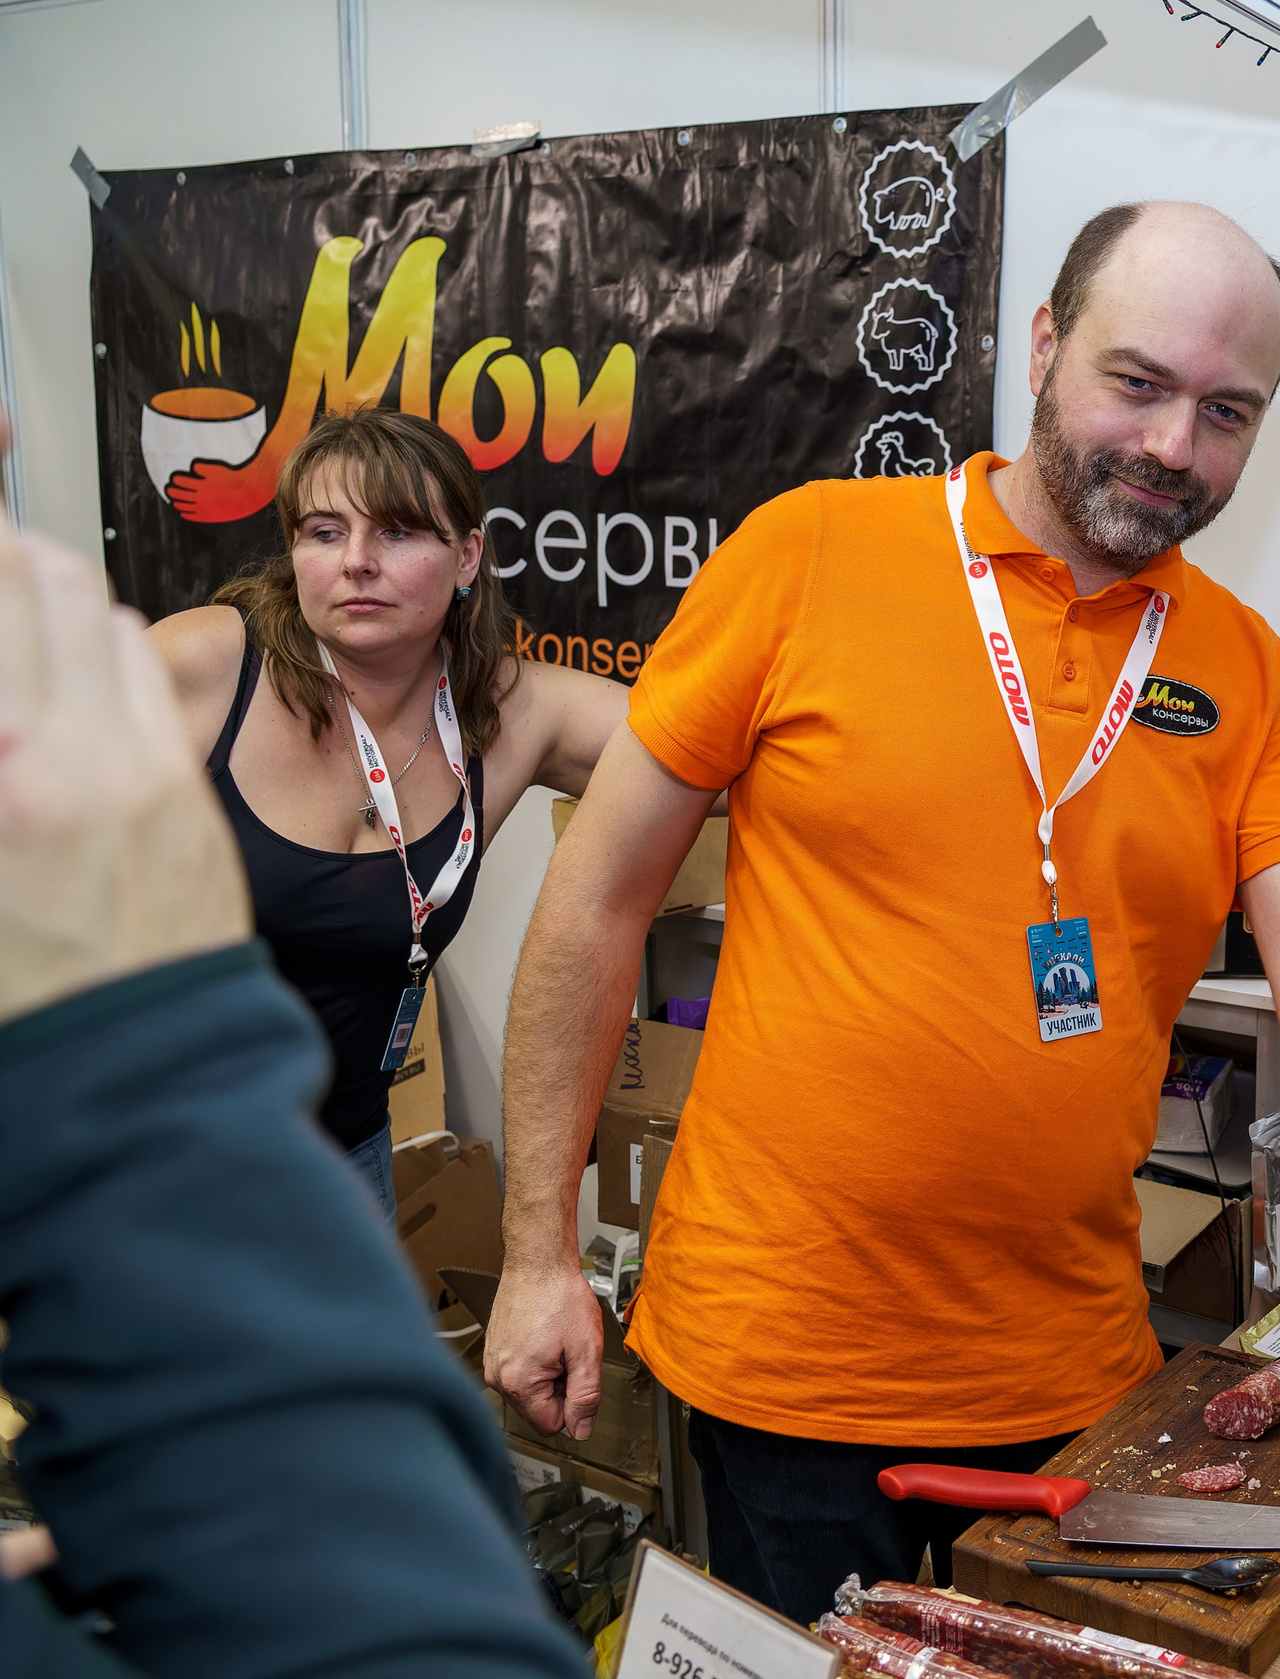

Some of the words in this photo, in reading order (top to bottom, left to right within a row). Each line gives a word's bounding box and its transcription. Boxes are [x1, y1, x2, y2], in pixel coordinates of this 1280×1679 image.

[285, 236, 637, 476] Мои
[989, 631, 1030, 726] MOTO
[1092, 679, 1134, 766] MOTO
[1152, 707, 1209, 728] консервы
[361, 737, 375, 769] UNIVERSAL
[369, 743, 379, 768] MOTORS
[1046, 1012, 1097, 1036] УЧАСТНИК
[661, 1612, 679, 1629] Для
[679, 1624, 719, 1656] перевода
[719, 1650, 731, 1664] по
